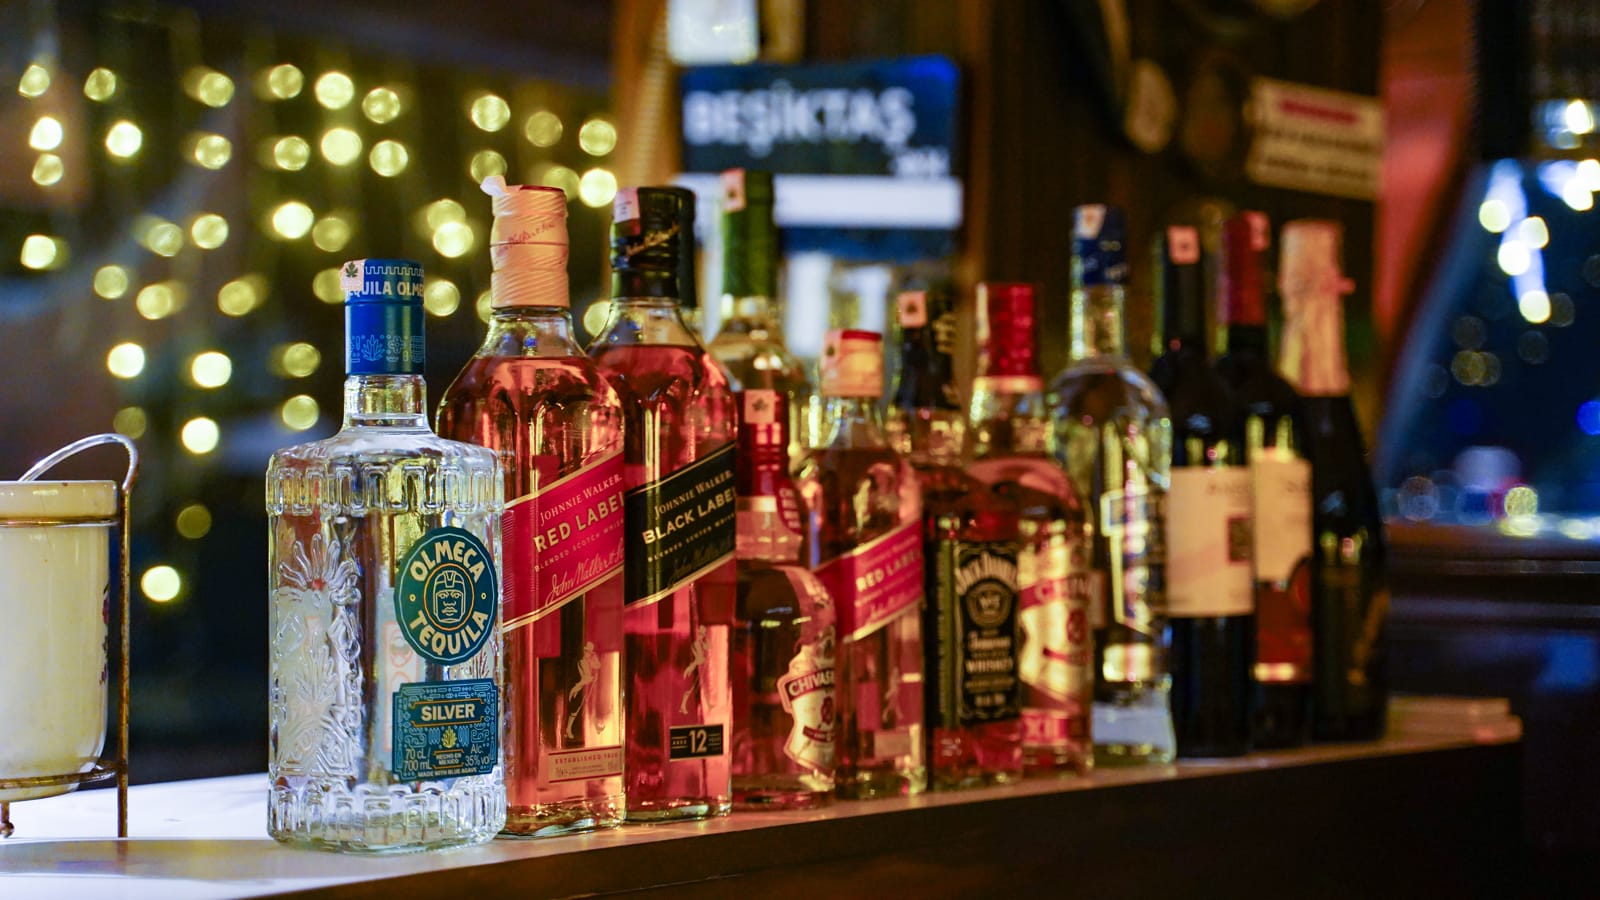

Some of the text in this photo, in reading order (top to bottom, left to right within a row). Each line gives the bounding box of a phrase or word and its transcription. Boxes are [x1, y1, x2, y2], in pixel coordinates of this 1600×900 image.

[540, 494, 582, 526] JOHNNIE
[654, 491, 695, 521] JOHNNIE
[533, 522, 571, 553] RED
[642, 509, 696, 545] BLACK
[410, 540, 485, 582] OLMECA
[534, 549, 570, 573] BLENDED
[855, 568, 885, 592] RED
[409, 610, 488, 656] TEQUILA
[421, 703, 475, 721] SILVER
[688, 729, 708, 753] 12
[403, 759, 419, 771] 700
[405, 749, 416, 760] 70
[465, 754, 481, 767] 35%
[554, 754, 601, 765] ESTABLISHED
